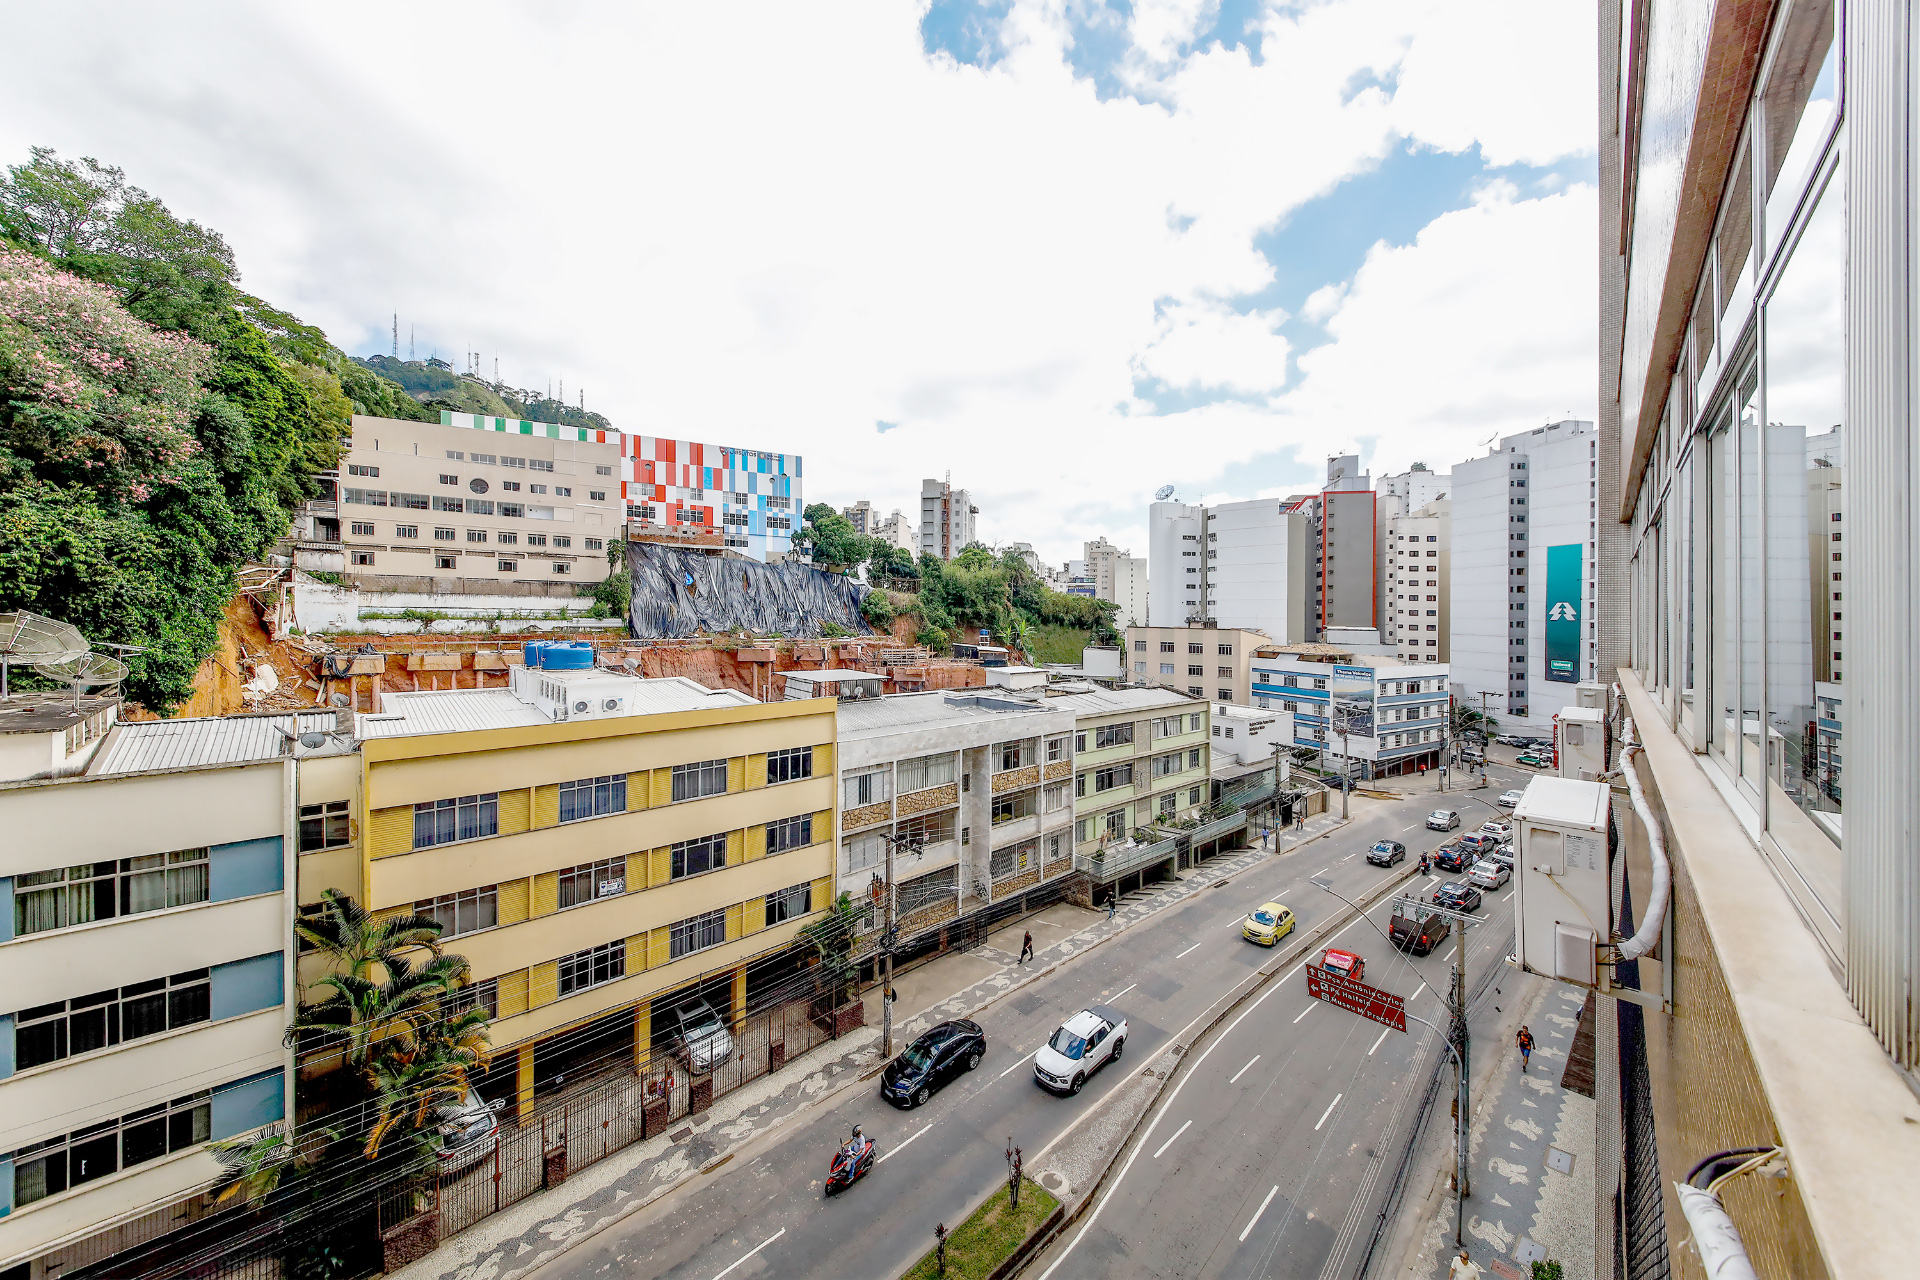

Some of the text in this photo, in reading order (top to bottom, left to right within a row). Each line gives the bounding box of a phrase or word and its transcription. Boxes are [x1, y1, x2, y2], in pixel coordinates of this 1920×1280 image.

[1344, 981, 1376, 998] Antônio
[1377, 993, 1404, 1008] Carlos
[1331, 996, 1356, 1012] Museu
[1367, 1010, 1404, 1029] Procópio
